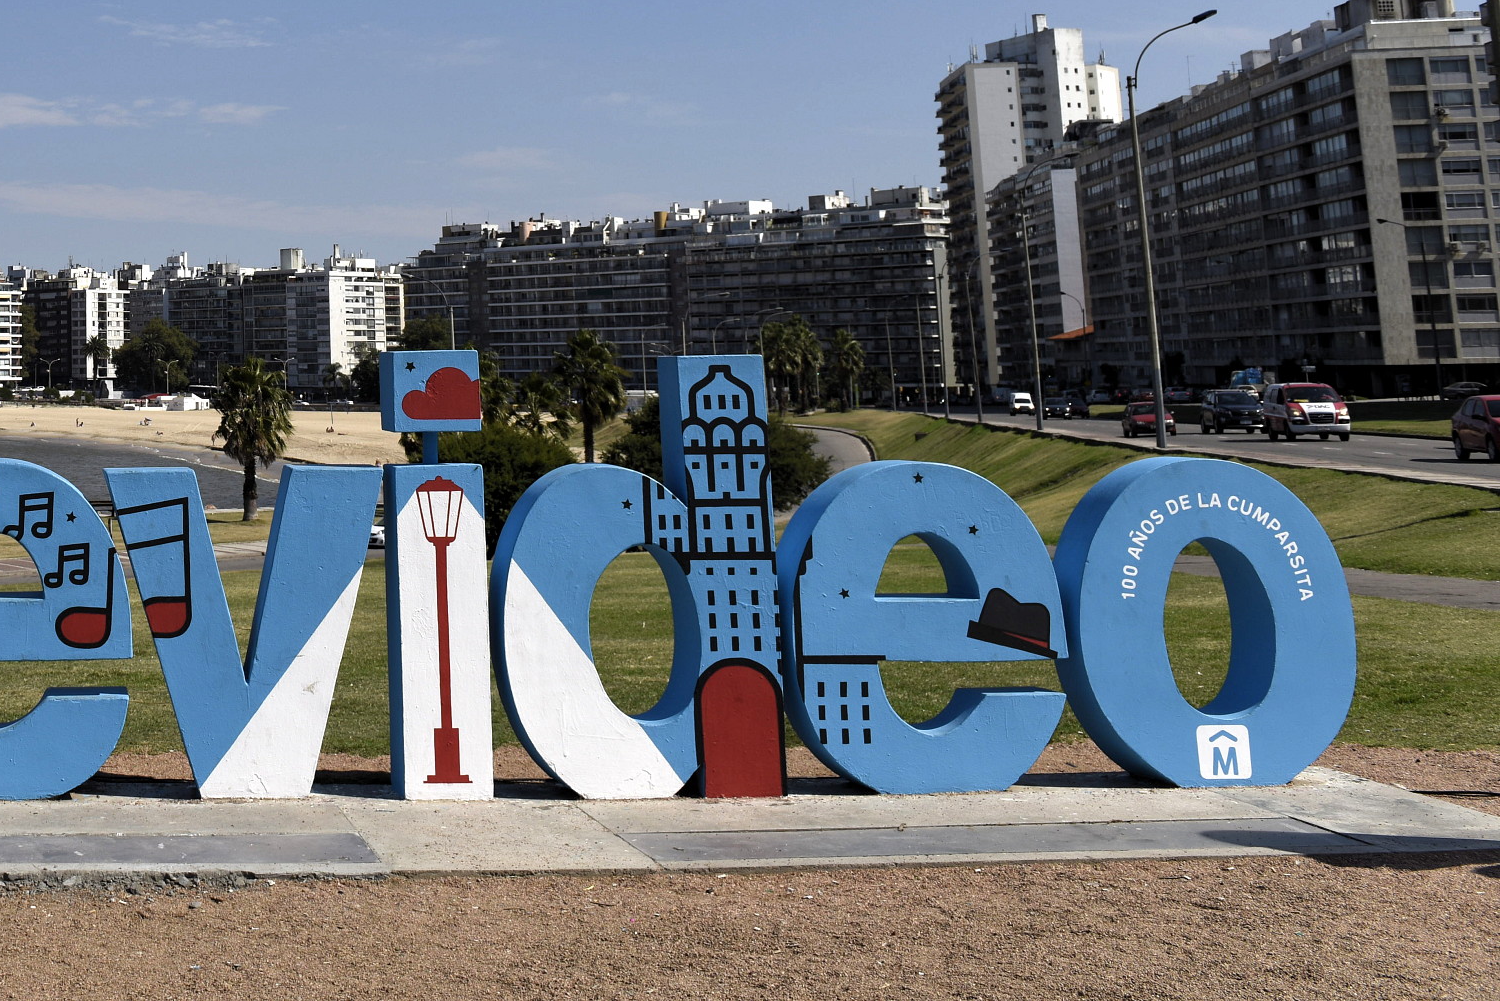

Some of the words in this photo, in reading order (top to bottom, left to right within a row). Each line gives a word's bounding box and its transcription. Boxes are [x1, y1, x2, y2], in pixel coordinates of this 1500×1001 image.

[1165, 494, 1192, 515] DE
[1197, 492, 1222, 508] LA
[1127, 509, 1164, 560] AÑOS
[1227, 495, 1314, 601] CUMPARSITA
[1121, 565, 1138, 599] 100
[1213, 746, 1239, 775] M
